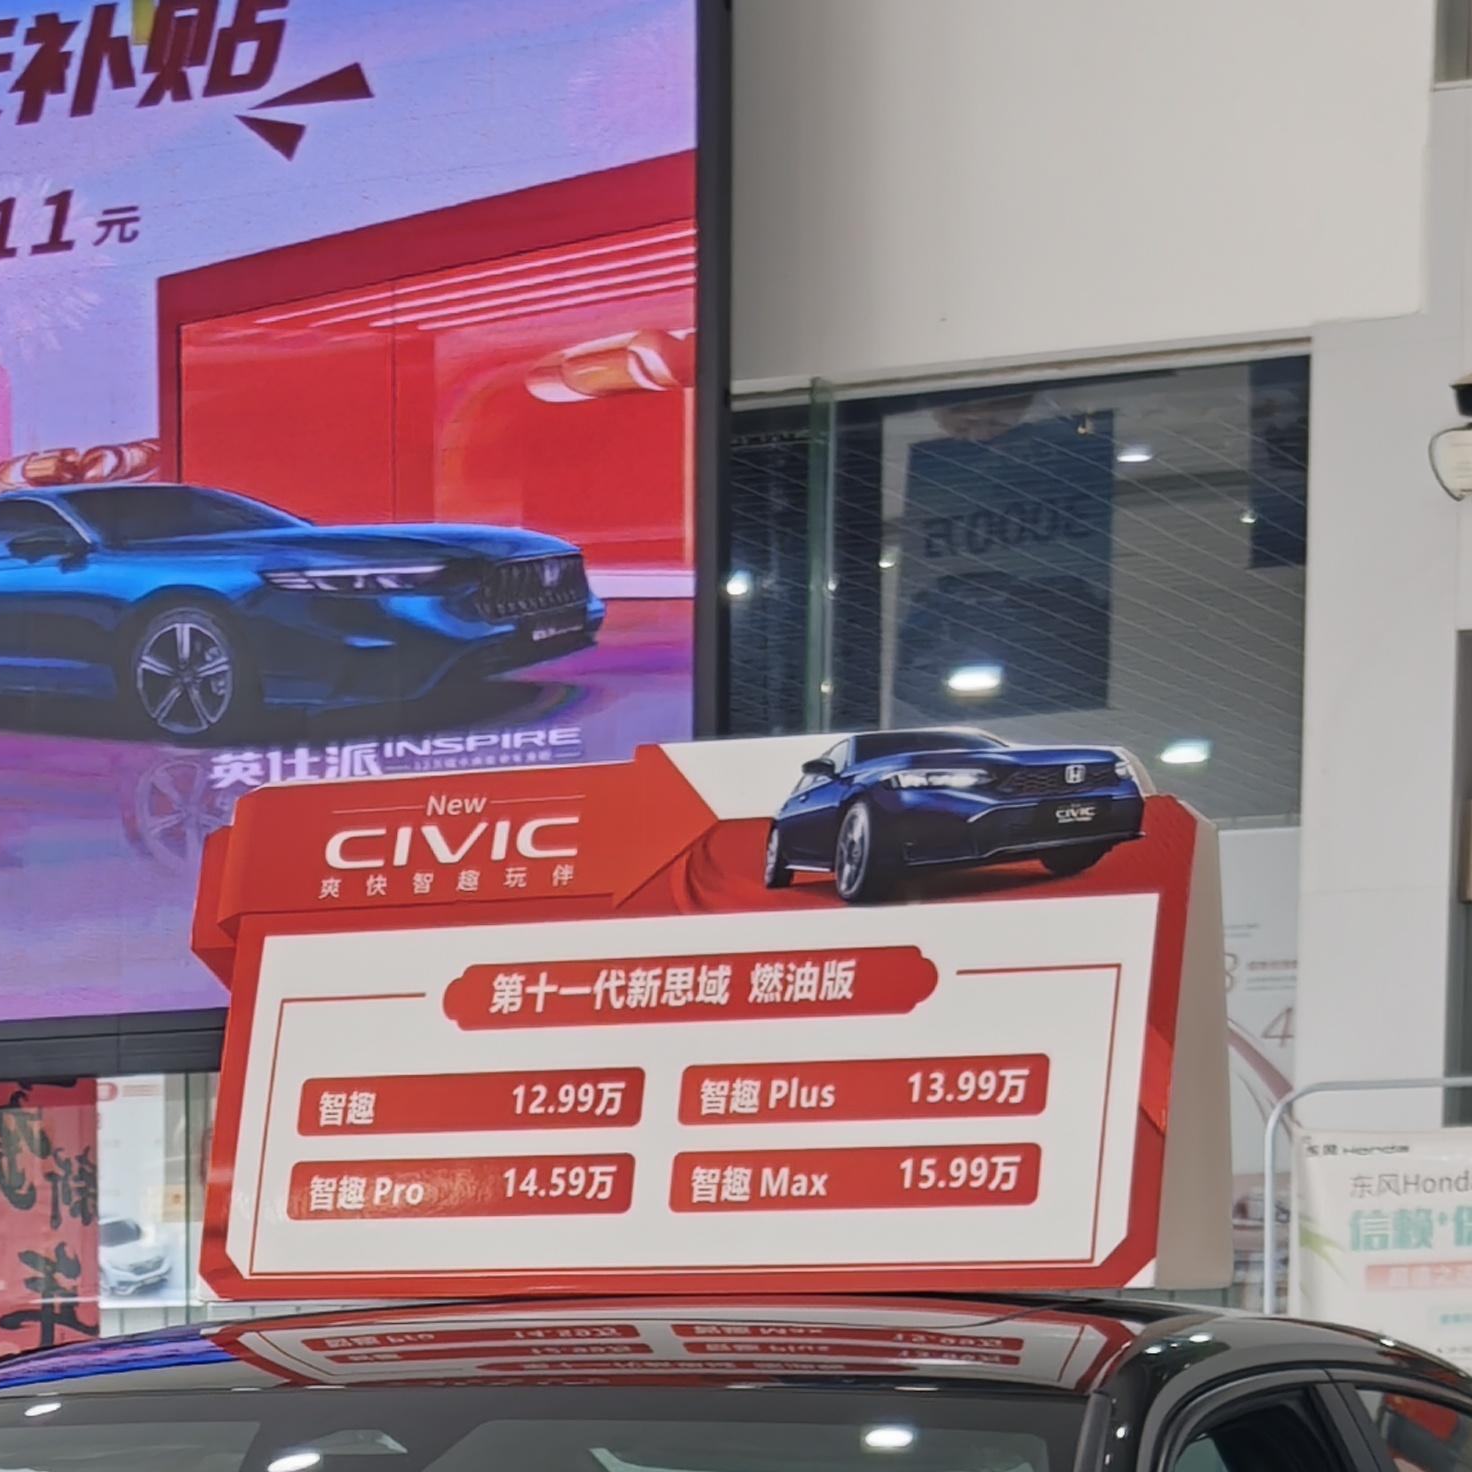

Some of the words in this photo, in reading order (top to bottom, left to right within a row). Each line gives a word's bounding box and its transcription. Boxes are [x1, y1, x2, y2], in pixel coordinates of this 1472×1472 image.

[209, 742, 383, 789] 英仕派
[383, 727, 583, 759] INSPIRE
[425, 795, 488, 818] New
[324, 816, 580, 871] CIVIC
[317, 863, 576, 900] 爽快智趣玩伴
[488, 963, 733, 1015] 第十一代新思域
[747, 957, 857, 1004] 燃油版
[318, 1090, 377, 1128] 智趣
[511, 1081, 627, 1117] 12.99万
[699, 1077, 762, 1116] 智趣
[767, 1077, 837, 1110] Plus
[906, 1067, 1031, 1105] 13.99万
[309, 1174, 368, 1212] 智趣
[374, 1176, 426, 1206] Pro
[502, 1165, 618, 1201] 14.59万
[690, 1165, 752, 1204] 智趣
[759, 1166, 829, 1198] Max
[898, 1154, 1022, 1192] 15.99万
